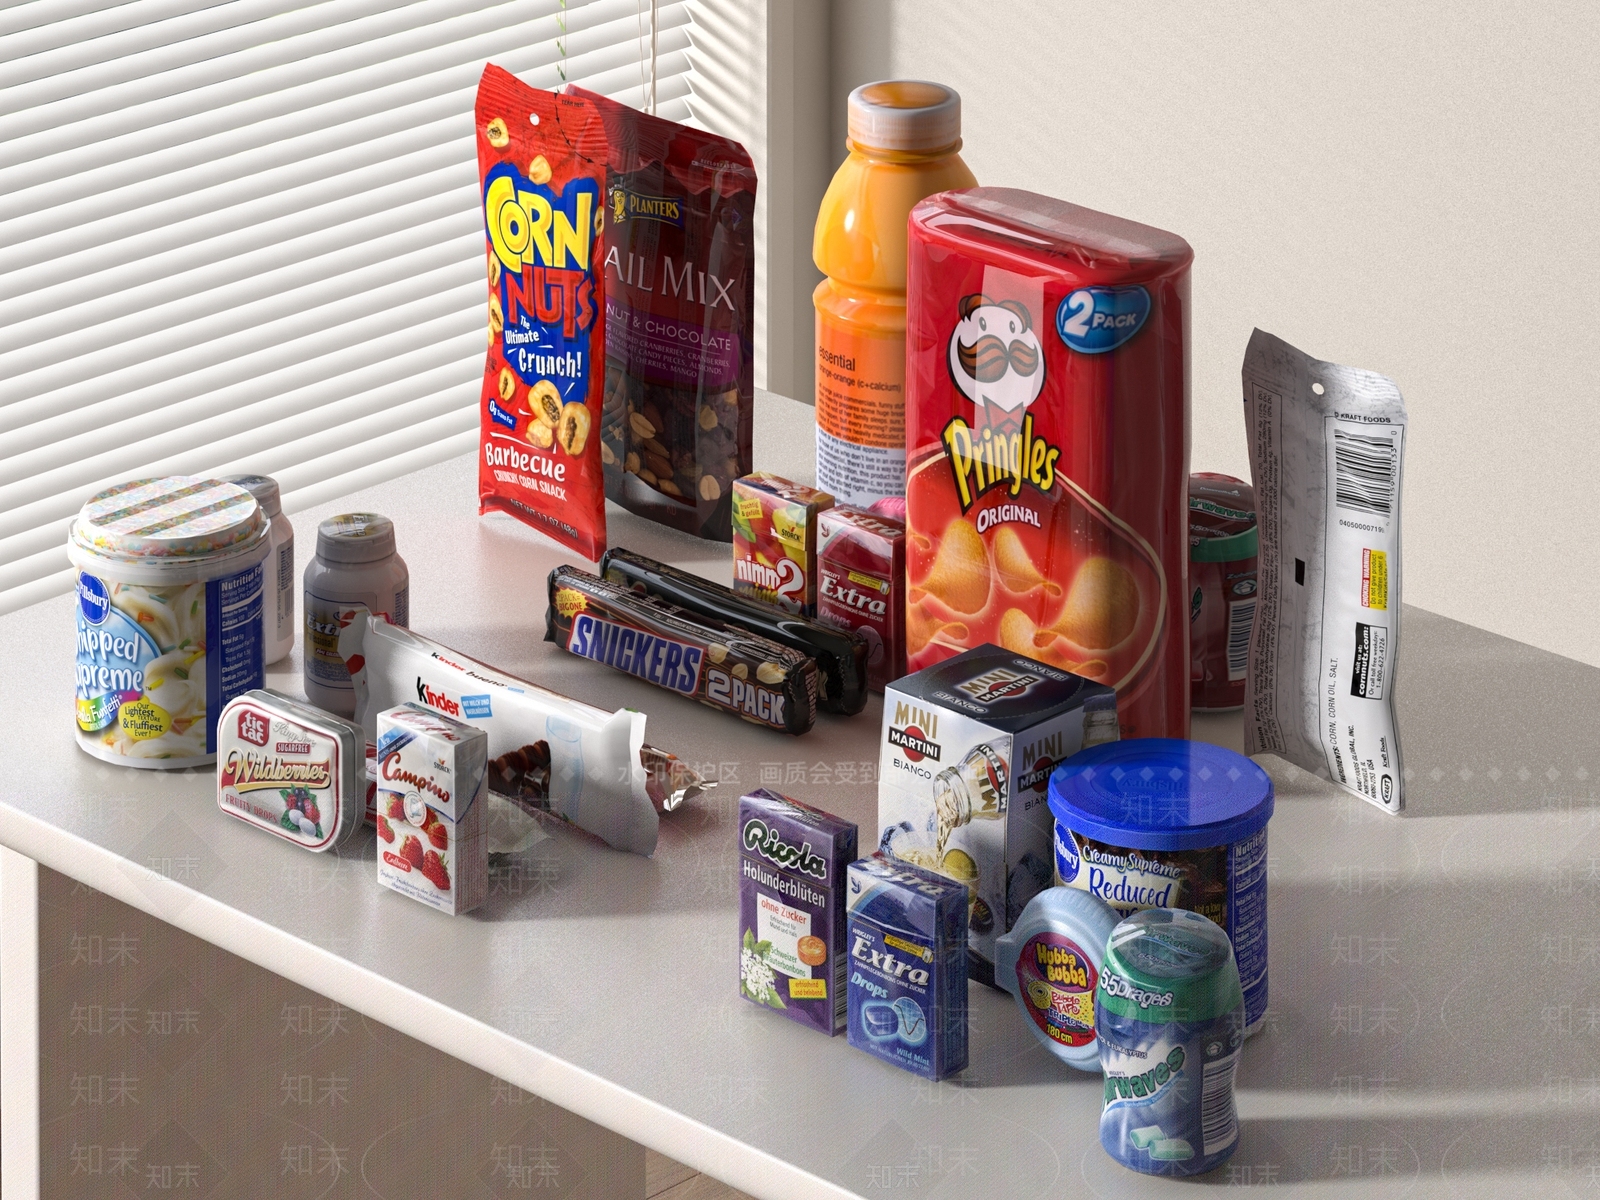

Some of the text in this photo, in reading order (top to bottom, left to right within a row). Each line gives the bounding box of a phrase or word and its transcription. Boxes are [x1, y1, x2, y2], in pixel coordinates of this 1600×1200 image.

[630, 194, 680, 220] PLANTERS
[485, 176, 593, 273] CORN
[604, 246, 736, 311] AIL MIX
[505, 265, 593, 338] NUTS
[520, 315, 530, 330] The
[1061, 290, 1136, 339] 2 PACK
[504, 329, 540, 345] Ultimate
[632, 315, 641, 329] &
[645, 320, 731, 351] CHOCOLATE
[518, 347, 582, 378] Crunch!
[638, 348, 661, 361] CANDY
[819, 346, 856, 372] essential
[670, 365, 698, 378] MANGO
[857, 378, 902, 393] (c+calcium)
[1341, 411, 1391, 424] KRAFT FOODS
[485, 442, 566, 482] Barbecue
[942, 412, 1061, 513] Pringles
[1390, 447, 1398, 477] 00133
[493, 469, 568, 502] CRUNCHY CORN SNACK
[510, 498, 523, 509] NET
[524, 506, 536, 516] WT
[549, 516, 559, 527] OZ
[976, 504, 1042, 534] ORIGINAL
[781, 528, 801, 541] STORCK
[221, 572, 254, 592] Nutrition
[820, 568, 841, 580] WRIGLEY'S
[1362, 549, 1371, 607] CHOKING WARNING
[1370, 575, 1378, 587] give
[820, 575, 887, 615] Extra
[1370, 597, 1377, 605] Do
[820, 606, 852, 628] Drops
[869, 614, 884, 623] ZUCKER
[572, 615, 705, 694] SNICKERS
[1358, 626, 1370, 695] cornnuts.com:
[1370, 657, 1378, 667] free
[1376, 637, 1386, 689] 1-800-622-4726
[466, 671, 506, 687] bueno
[1013, 659, 1067, 681] BIANCO
[1329, 657, 1339, 678] SALT.
[960, 669, 1018, 695] MINI
[980, 676, 1034, 702] MARTINI
[1327, 680, 1336, 696] OIL,
[1368, 687, 1375, 696] Or
[90, 694, 120, 721] Funfetti
[124, 706, 155, 717] Lightest
[136, 702, 149, 710] Our
[934, 691, 987, 713] BIANCO
[122, 718, 163, 732] & Fluffiest
[138, 715, 160, 723] TEXTURE
[245, 711, 264, 733] tic
[894, 700, 939, 739] MINI
[240, 723, 264, 745] tac
[890, 730, 939, 759] MARTINI
[1330, 720, 1338, 745] CORN,
[277, 743, 309, 754] SUGARFREE
[1022, 731, 1063, 771] MINI
[1347, 724, 1363, 792] KRAFT FOODS GLOBAL, INC.
[225, 746, 329, 784] Wildberries
[382, 751, 450, 803] Campino
[433, 761, 451, 775] STORCK
[893, 757, 932, 780] BIANCO
[1332, 745, 1347, 784] INGREDIENTS:
[253, 805, 278, 824] DROPS
[743, 818, 827, 880] Ricola
[1082, 844, 1181, 879] Creamy Supreme
[743, 859, 825, 908] Holunderblüten
[1089, 866, 1173, 909] Reduced
[761, 900, 807, 925] ohne Zucker
[769, 921, 781, 931] Mund
[781, 926, 789, 935] und
[852, 927, 876, 942] WRIGLEY'S
[851, 935, 930, 986] Extra
[1036, 942, 1077, 967] Hubba
[850, 971, 889, 999] Drops
[896, 979, 909, 988] OHNE
[909, 984, 926, 995] ZUCKER
[1046, 964, 1087, 988] Bubba
[1046, 1024, 1073, 1044] 180 cm
[896, 1047, 913, 1059] Wild
[913, 1053, 930, 1066] Mint
[1111, 1043, 1148, 1060] EUKALYPTUS
[1104, 1046, 1186, 1102] rwaves
